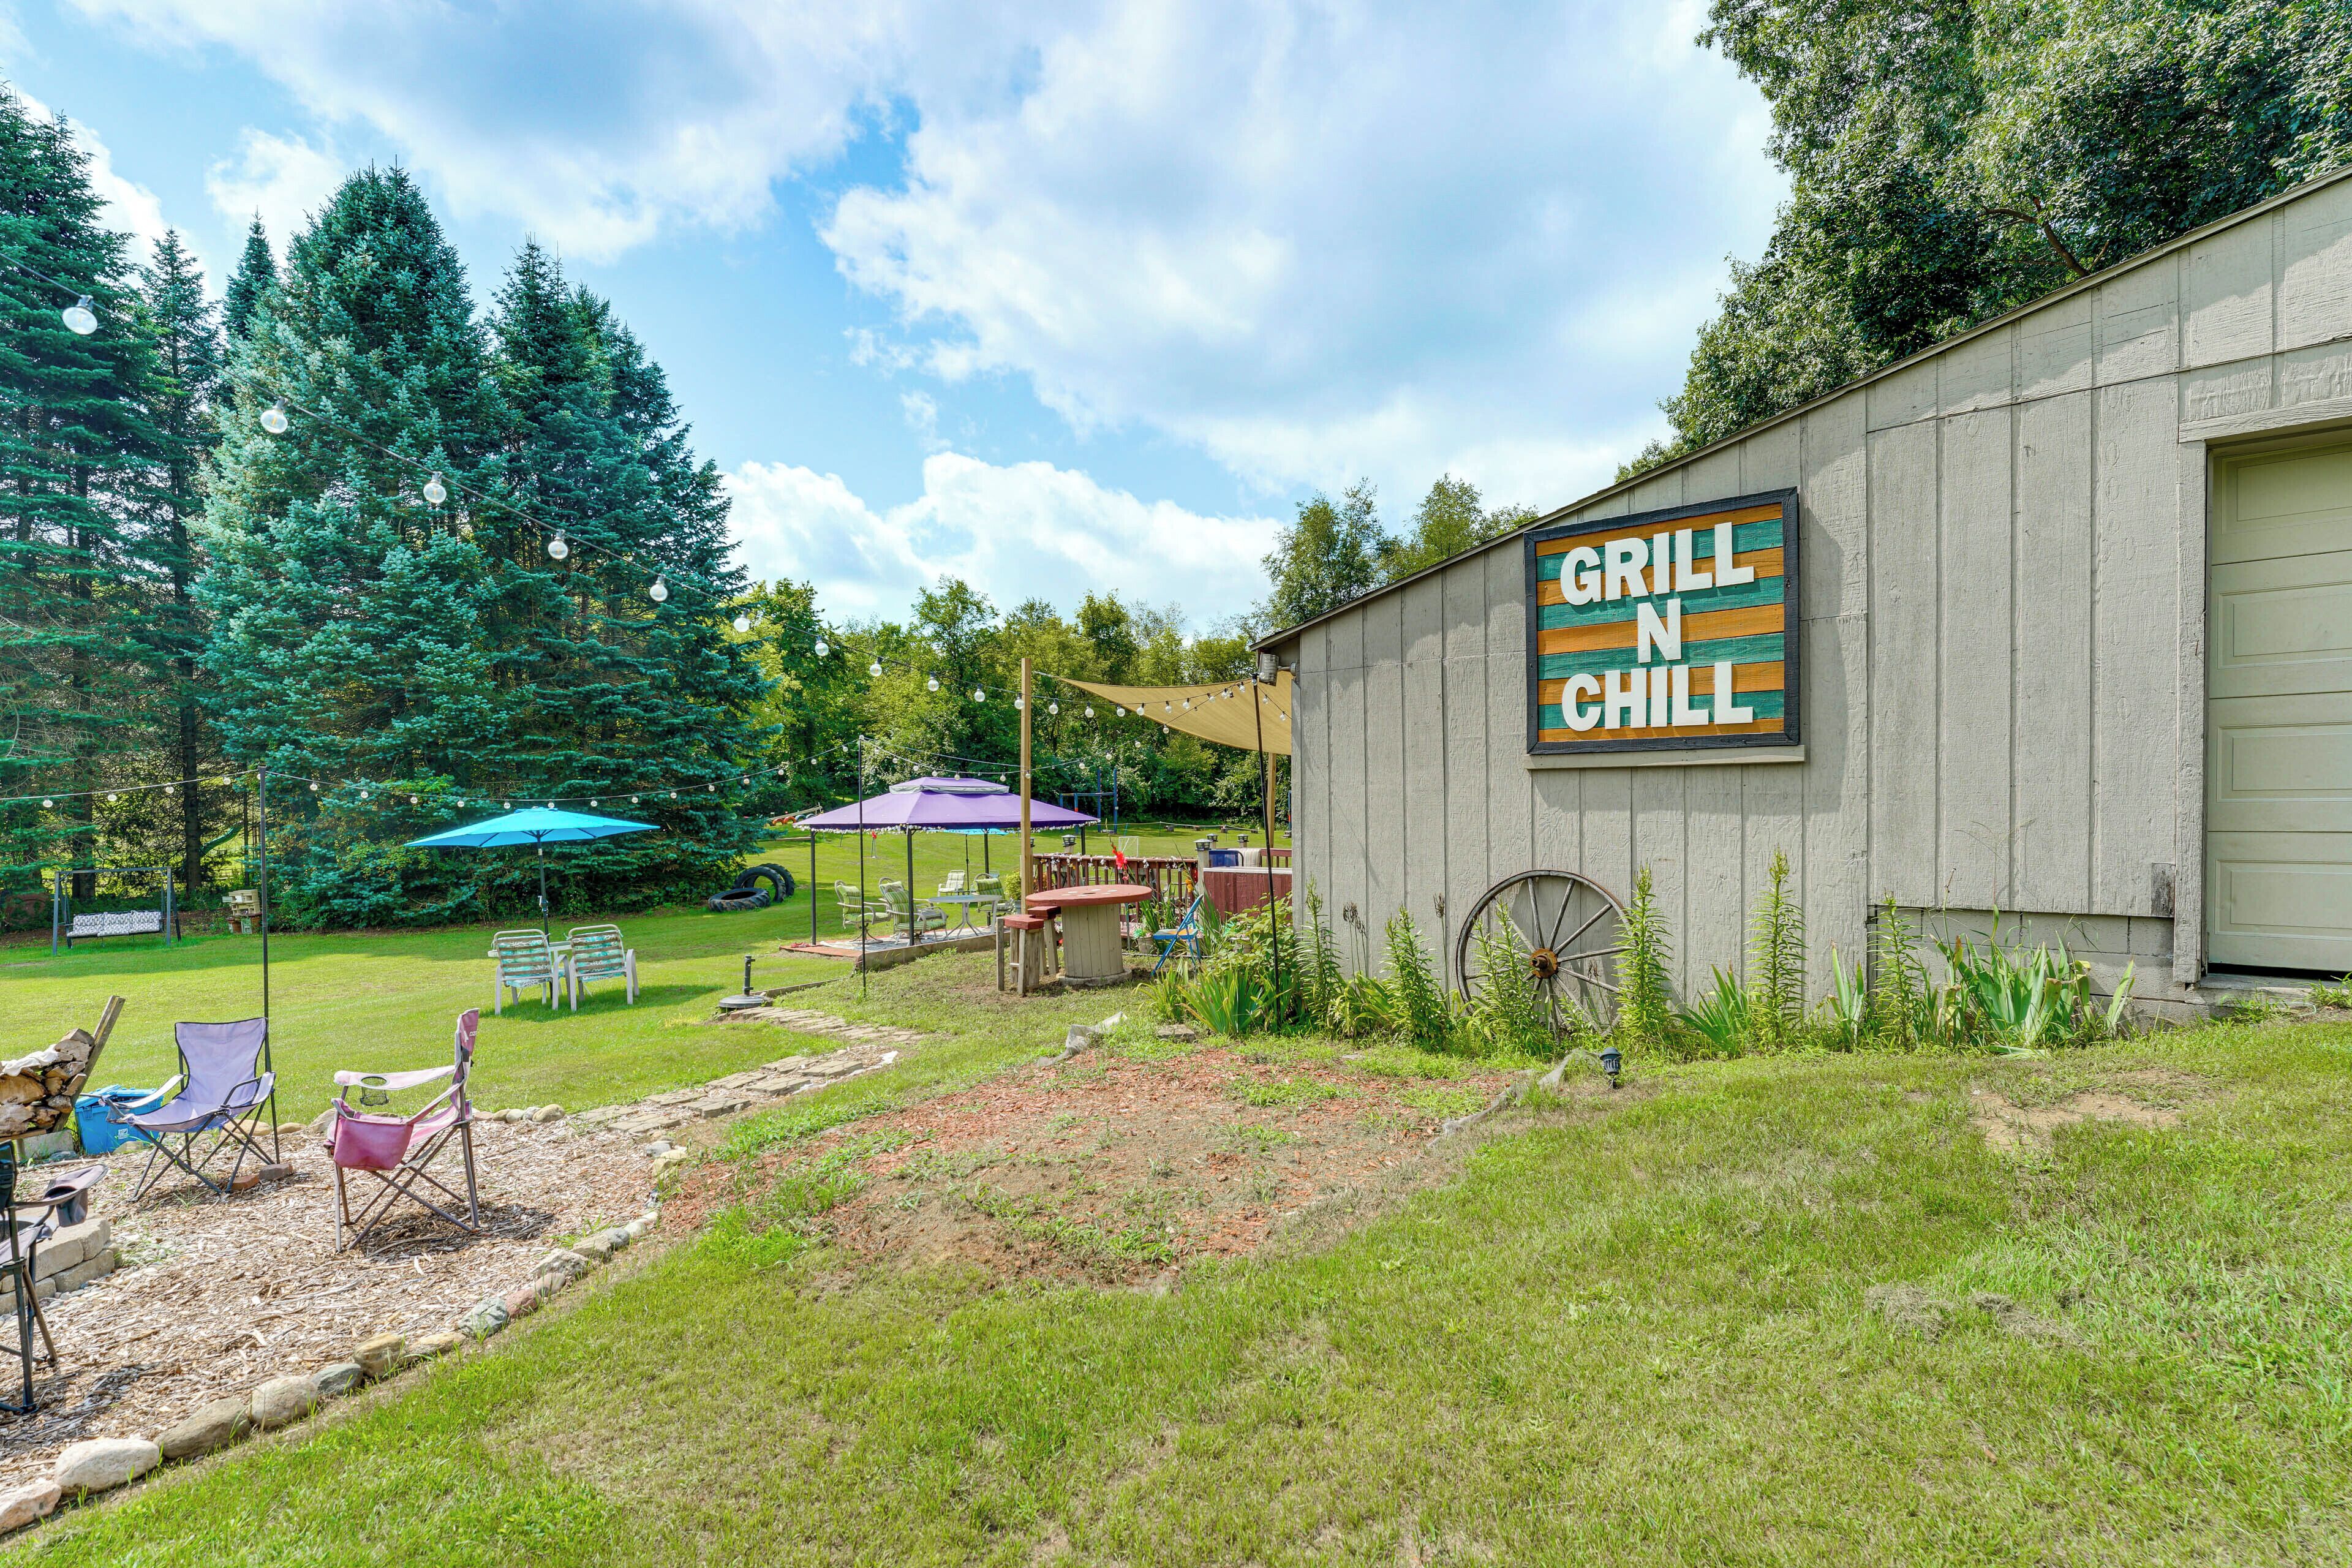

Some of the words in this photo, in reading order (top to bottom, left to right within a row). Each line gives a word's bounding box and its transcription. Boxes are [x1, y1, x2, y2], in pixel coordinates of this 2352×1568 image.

[1561, 522, 1754, 605] GRILL
[1637, 598, 1681, 663] N
[1561, 661, 1753, 731] CHILL
